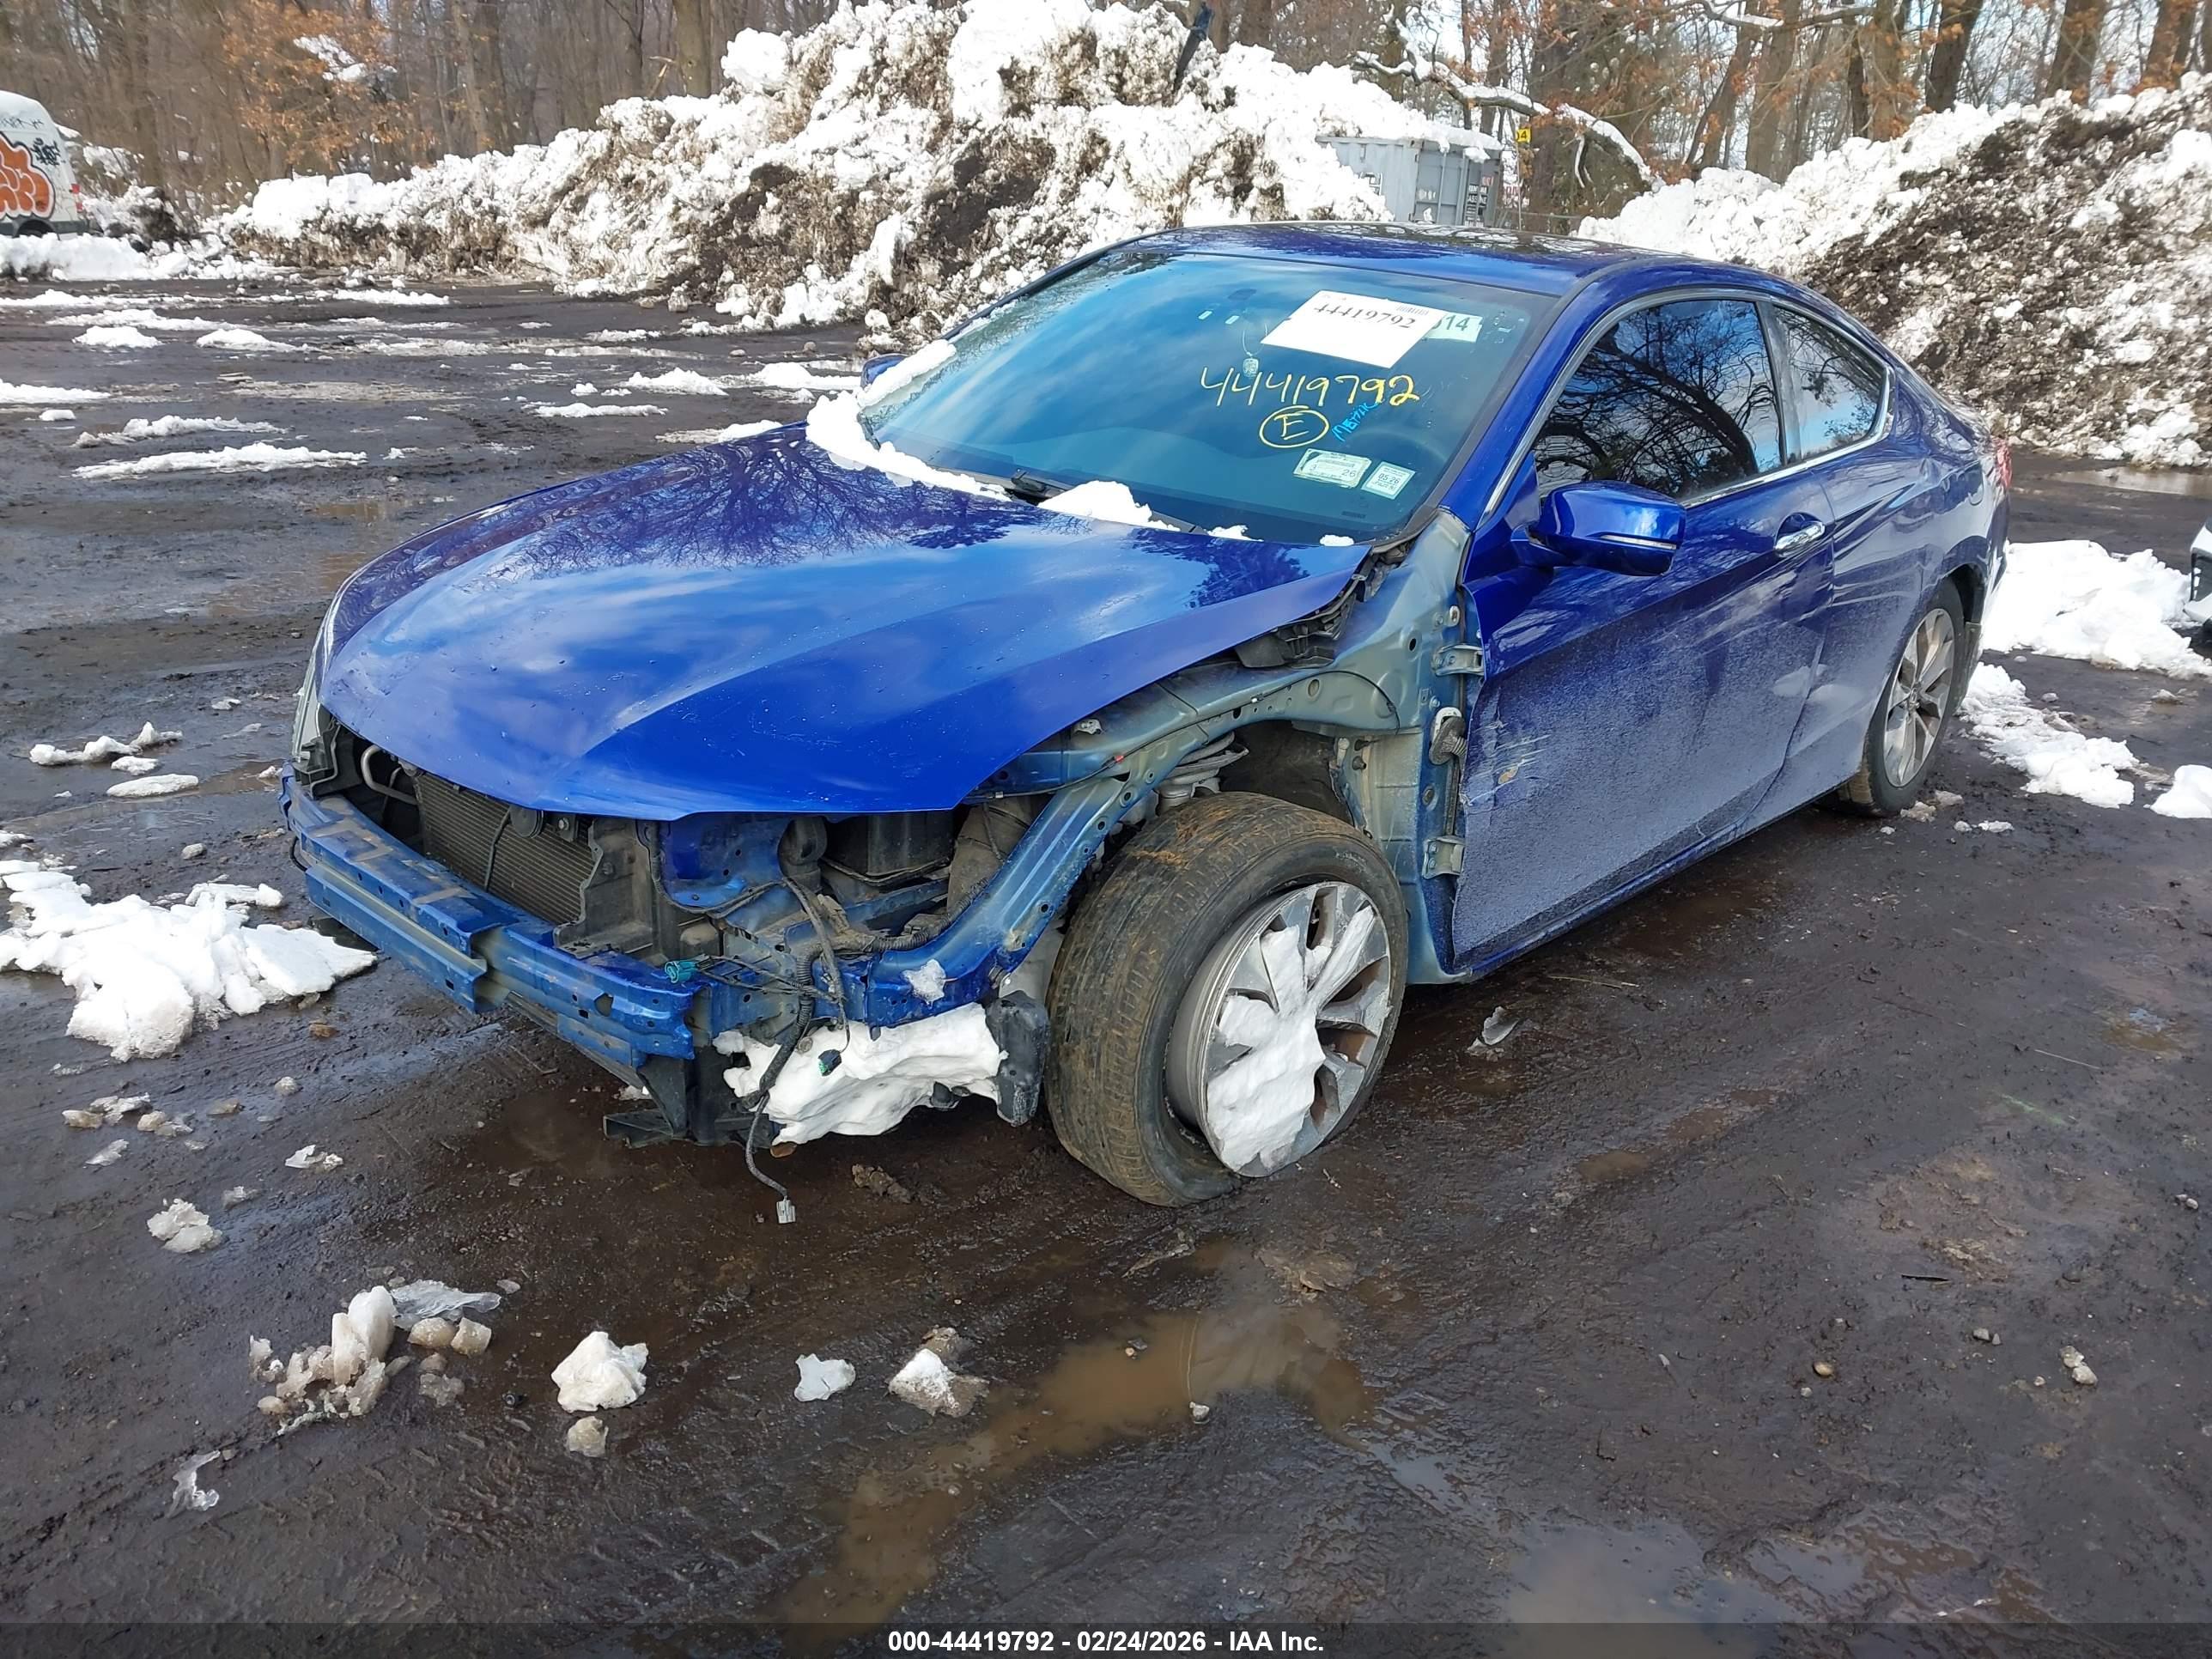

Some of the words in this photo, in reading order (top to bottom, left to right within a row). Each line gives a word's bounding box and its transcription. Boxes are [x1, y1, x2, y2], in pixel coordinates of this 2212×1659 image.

[1313, 303, 1416, 329] 44419792
[1200, 367, 1420, 407] 44419792
[1273, 411, 1310, 441] E
[1341, 469, 1357, 477] 26
